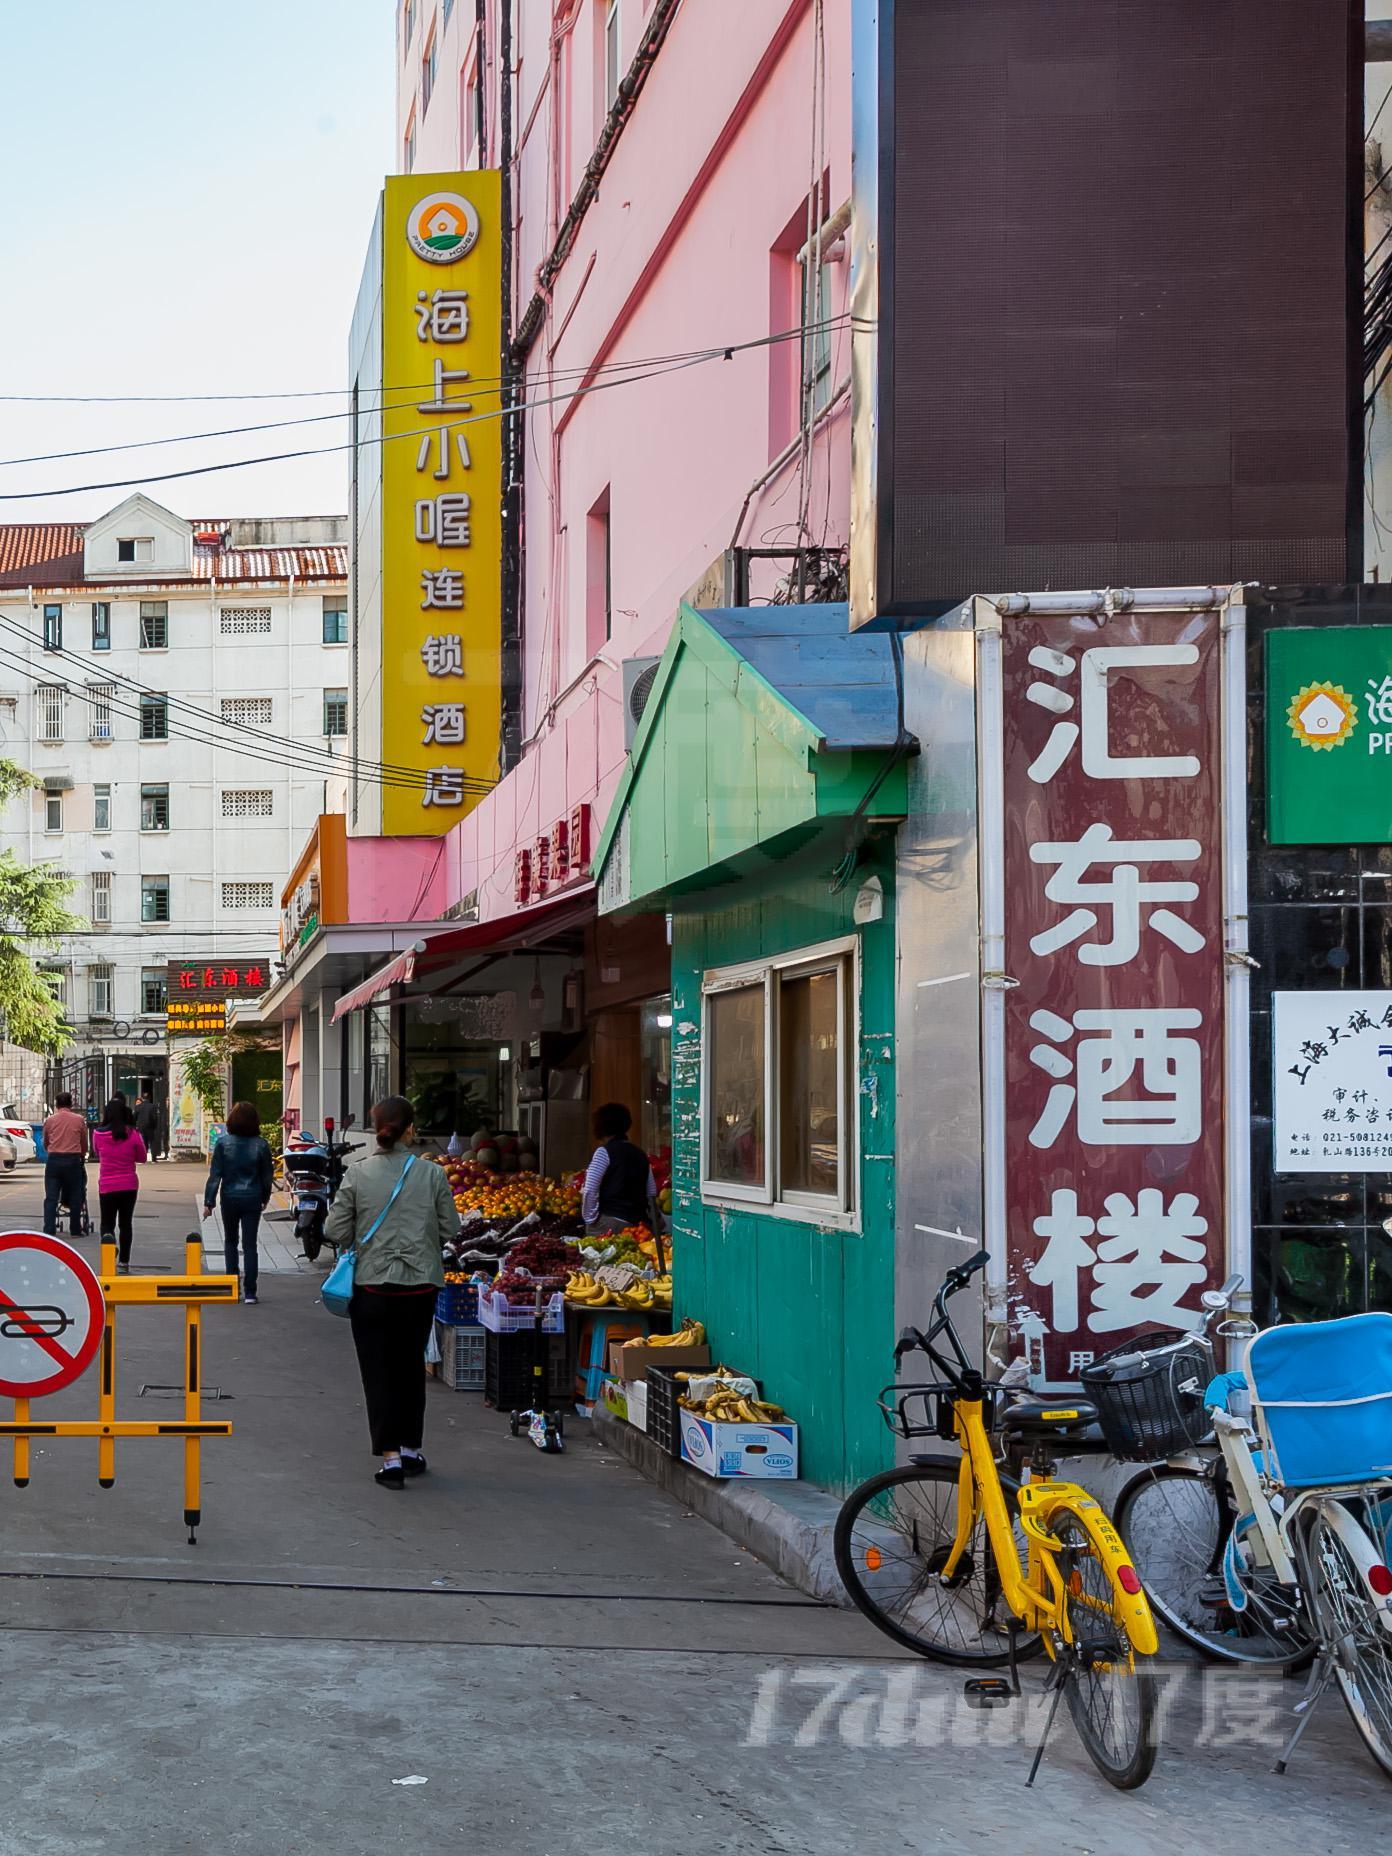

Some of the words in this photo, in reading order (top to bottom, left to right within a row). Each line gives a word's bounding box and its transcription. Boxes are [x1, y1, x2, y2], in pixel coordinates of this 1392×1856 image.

[412, 234, 444, 258] PRETTY
[449, 231, 475, 257] HOUSE
[415, 288, 473, 809] 海上小喔连锁酒店
[1026, 643, 1208, 1333] 汇东酒楼
